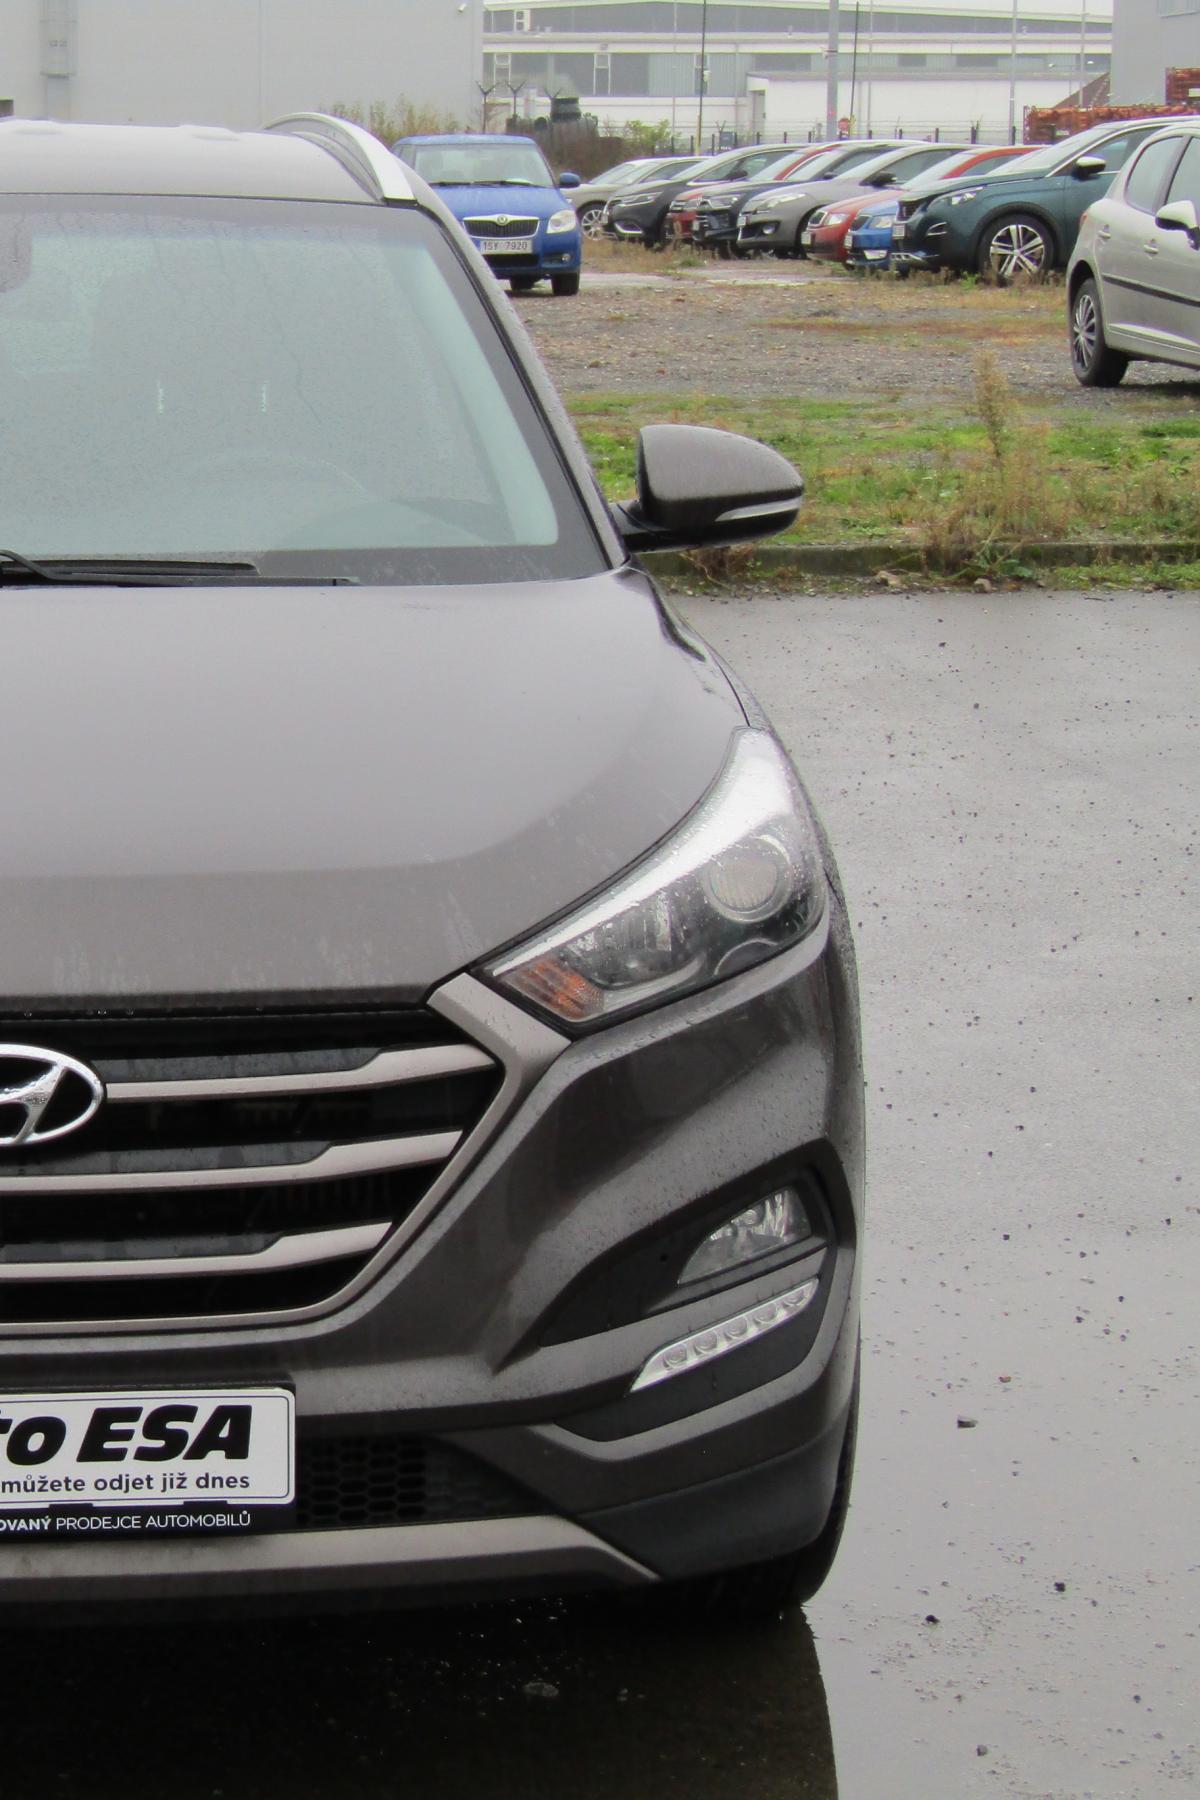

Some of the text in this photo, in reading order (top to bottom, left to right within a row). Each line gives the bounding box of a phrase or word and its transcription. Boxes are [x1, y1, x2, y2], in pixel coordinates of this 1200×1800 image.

[76, 1404, 253, 1462] ESA
[1, 1474, 86, 1493] můžete
[94, 1473, 154, 1494] odjet
[161, 1472, 188, 1493] již
[195, 1472, 250, 1489] dnes
[56, 1516, 141, 1530] PRODEJCE
[145, 1510, 251, 1528] AUTOMOBILŮ
